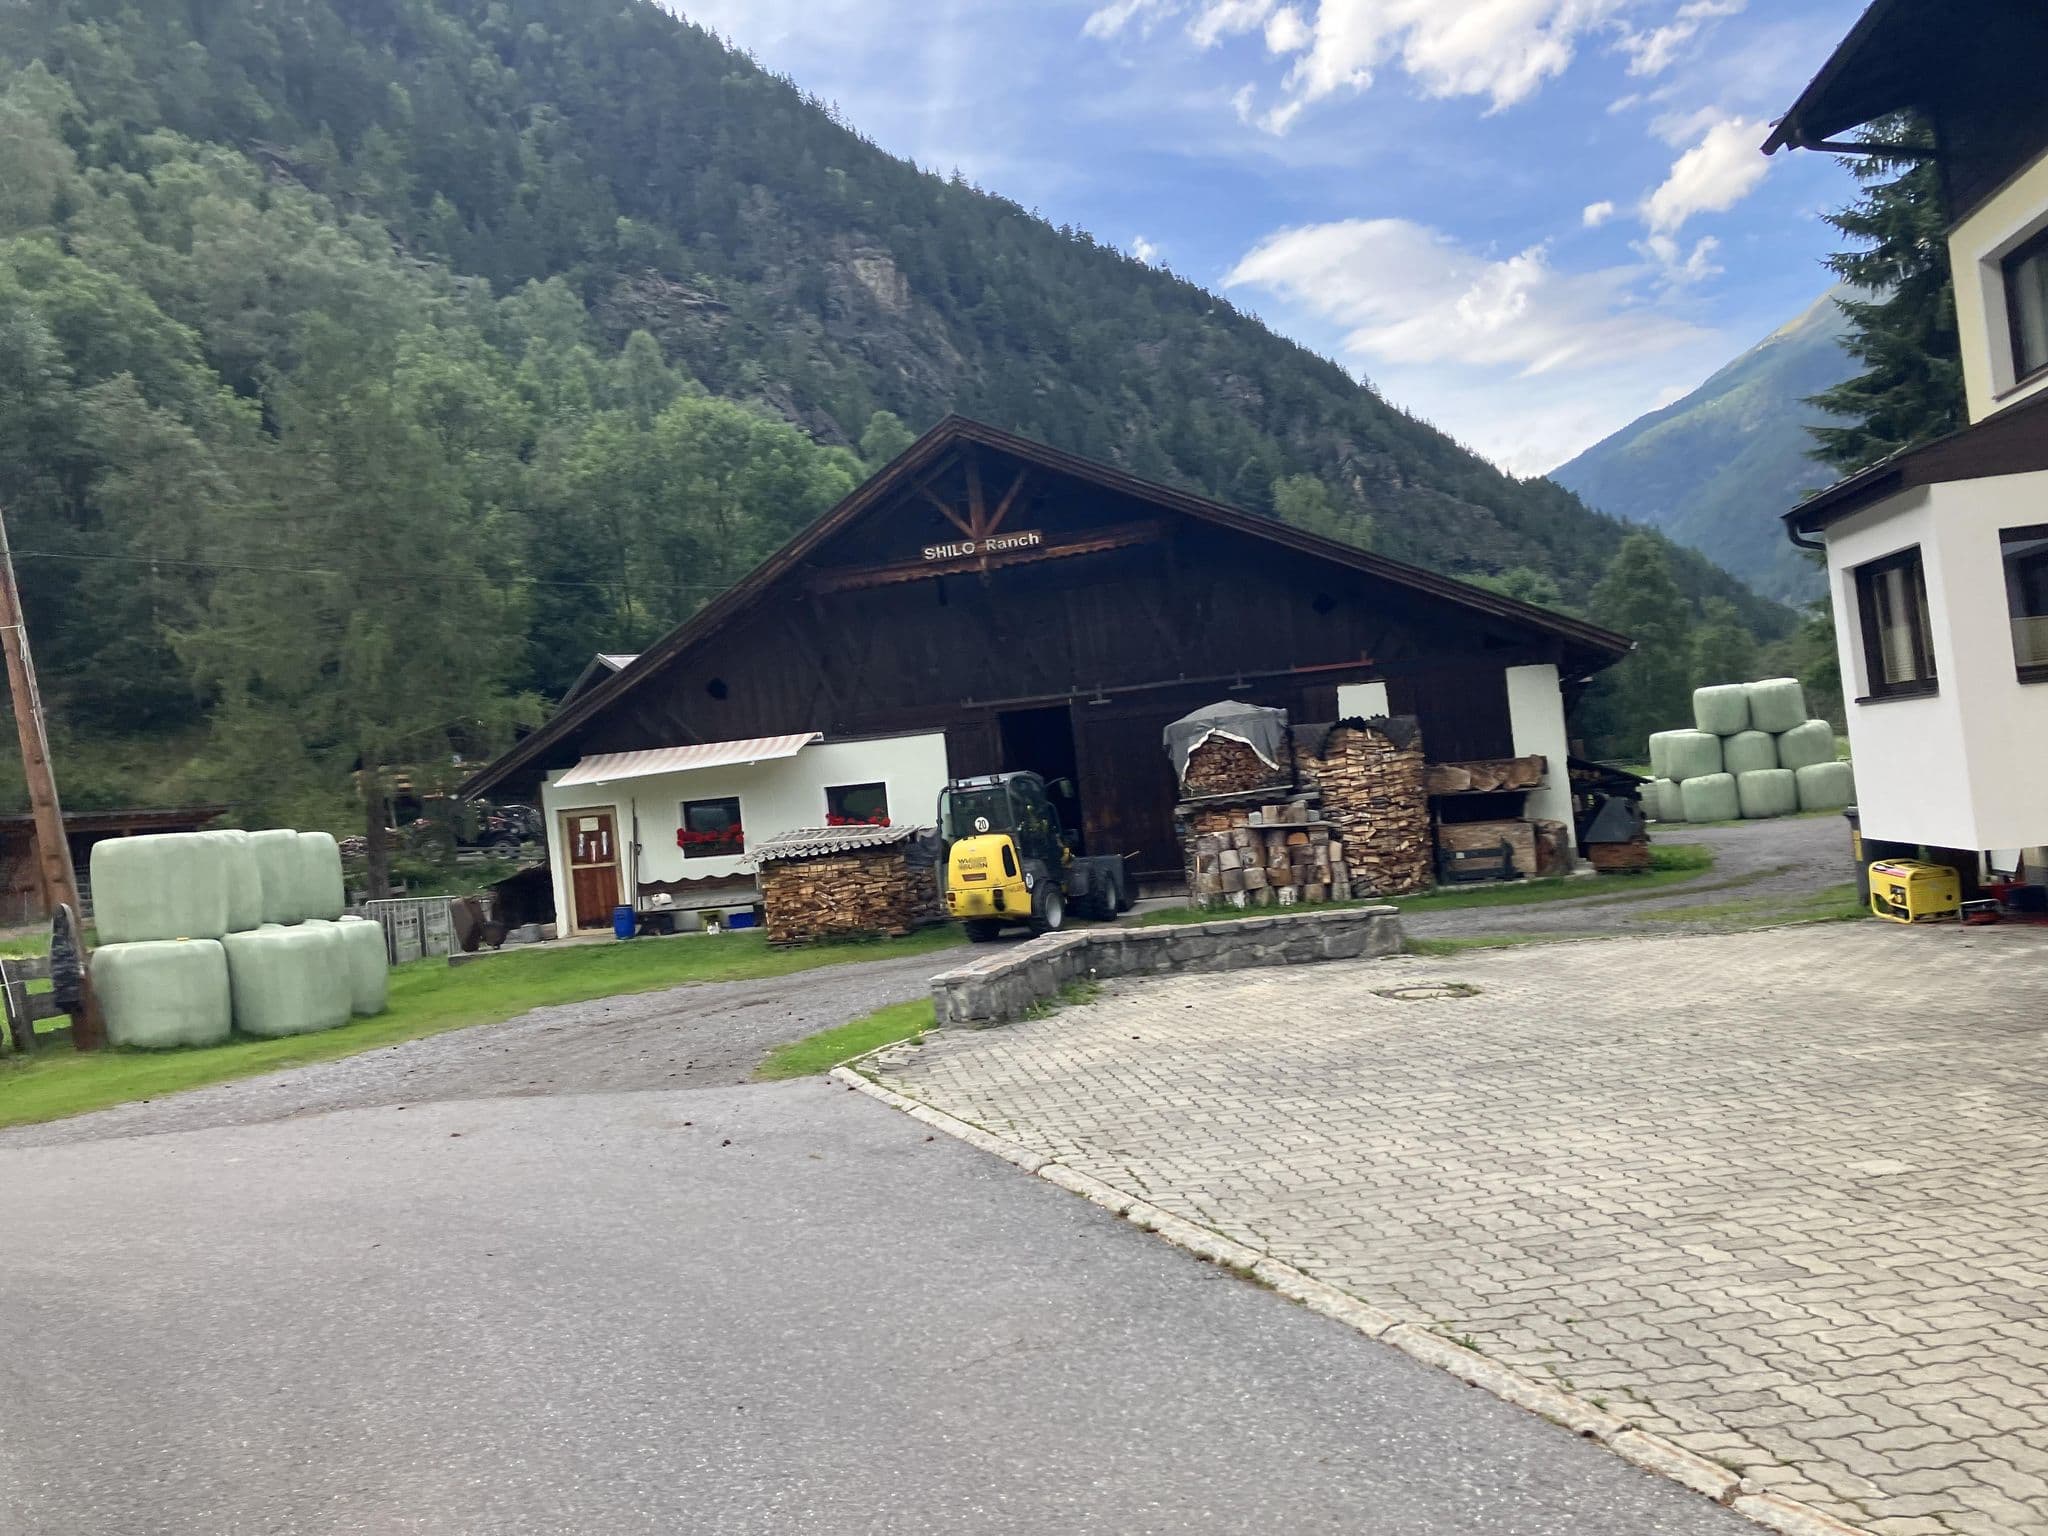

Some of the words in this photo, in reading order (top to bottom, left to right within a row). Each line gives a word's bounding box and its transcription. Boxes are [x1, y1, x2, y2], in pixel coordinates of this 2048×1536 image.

[924, 542, 975, 560] SHILO
[986, 533, 1040, 551] Ranch
[978, 819, 987, 830] 20
